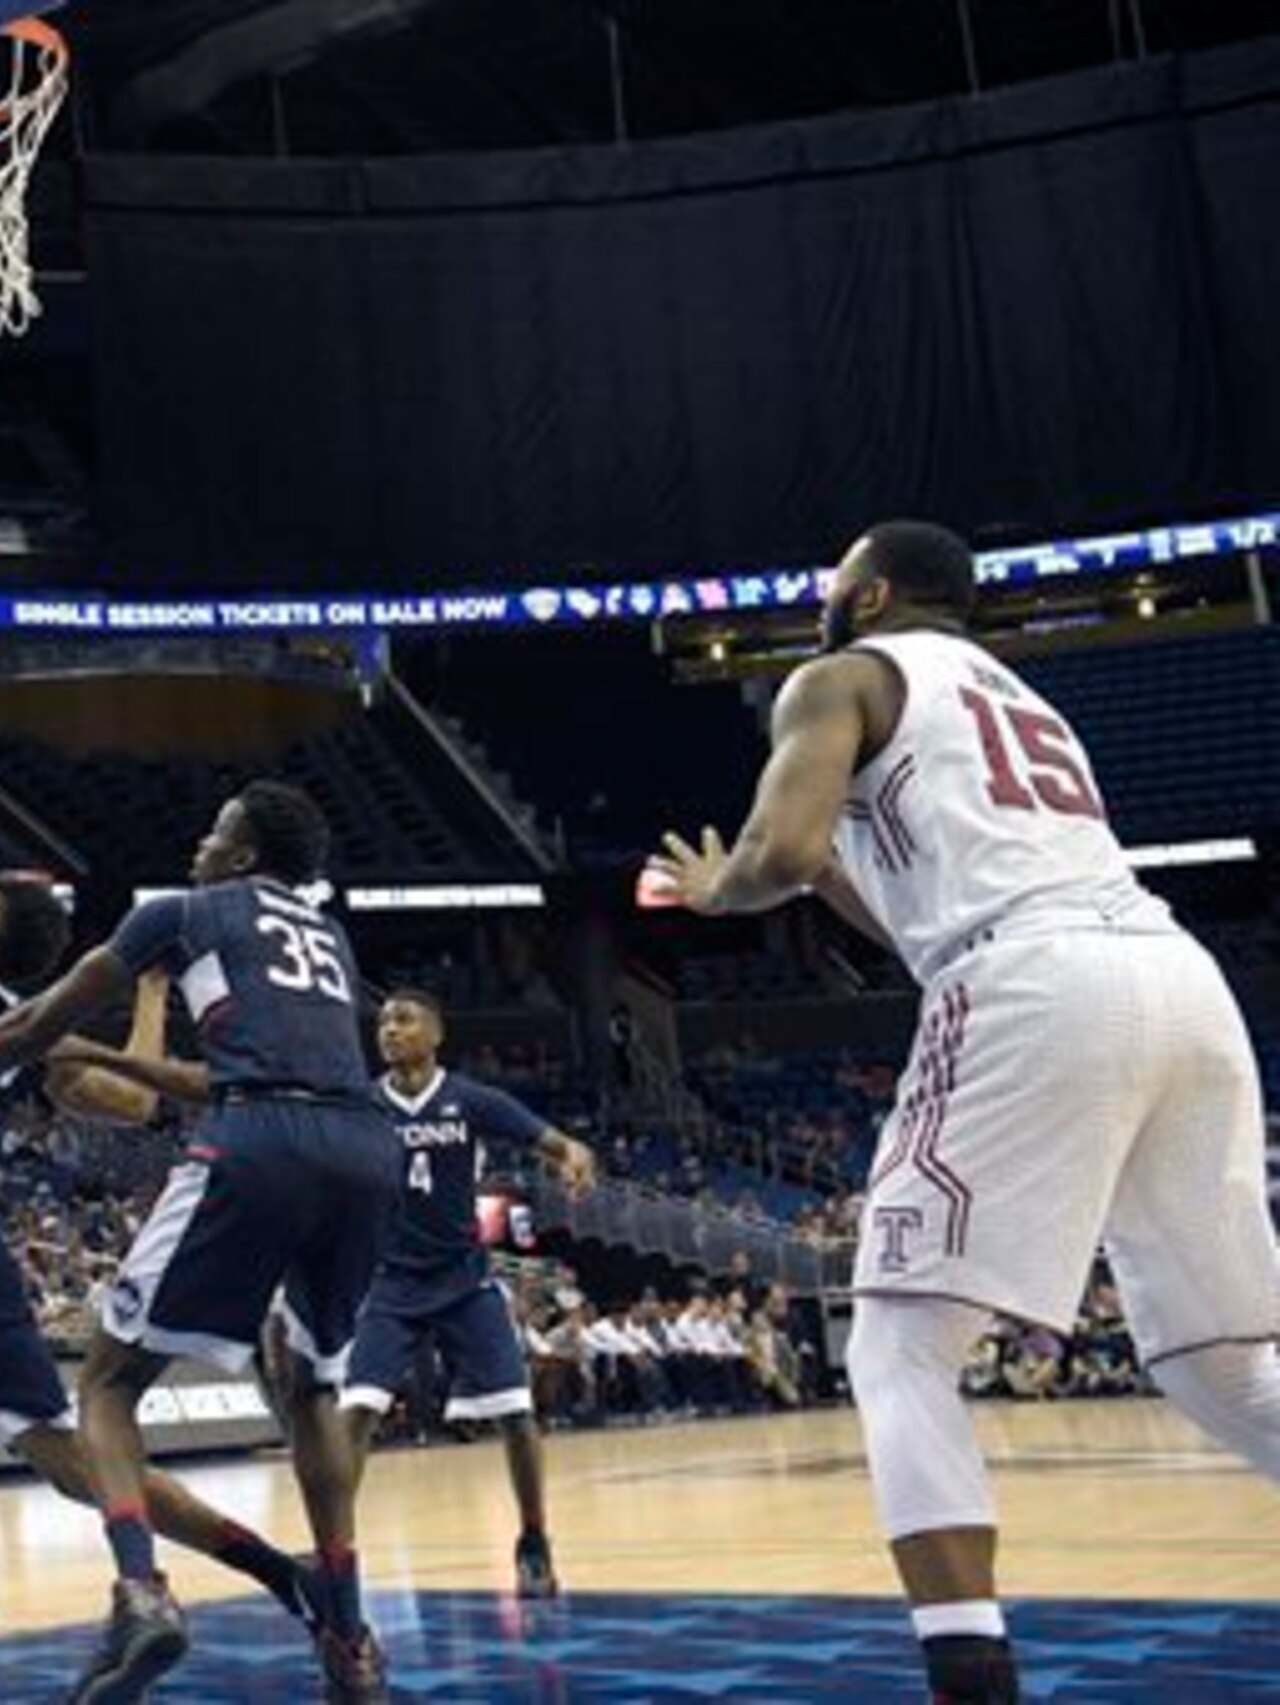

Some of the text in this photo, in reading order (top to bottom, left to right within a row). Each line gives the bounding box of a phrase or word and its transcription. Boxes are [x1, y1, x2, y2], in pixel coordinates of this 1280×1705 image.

[14, 597, 507, 626] SINGLE SESSION TICKETS ON SALE NOW
[957, 684, 1106, 820] 15
[255, 914, 351, 1003] 35
[409, 1151, 432, 1194] 4
[873, 1206, 924, 1273] T
